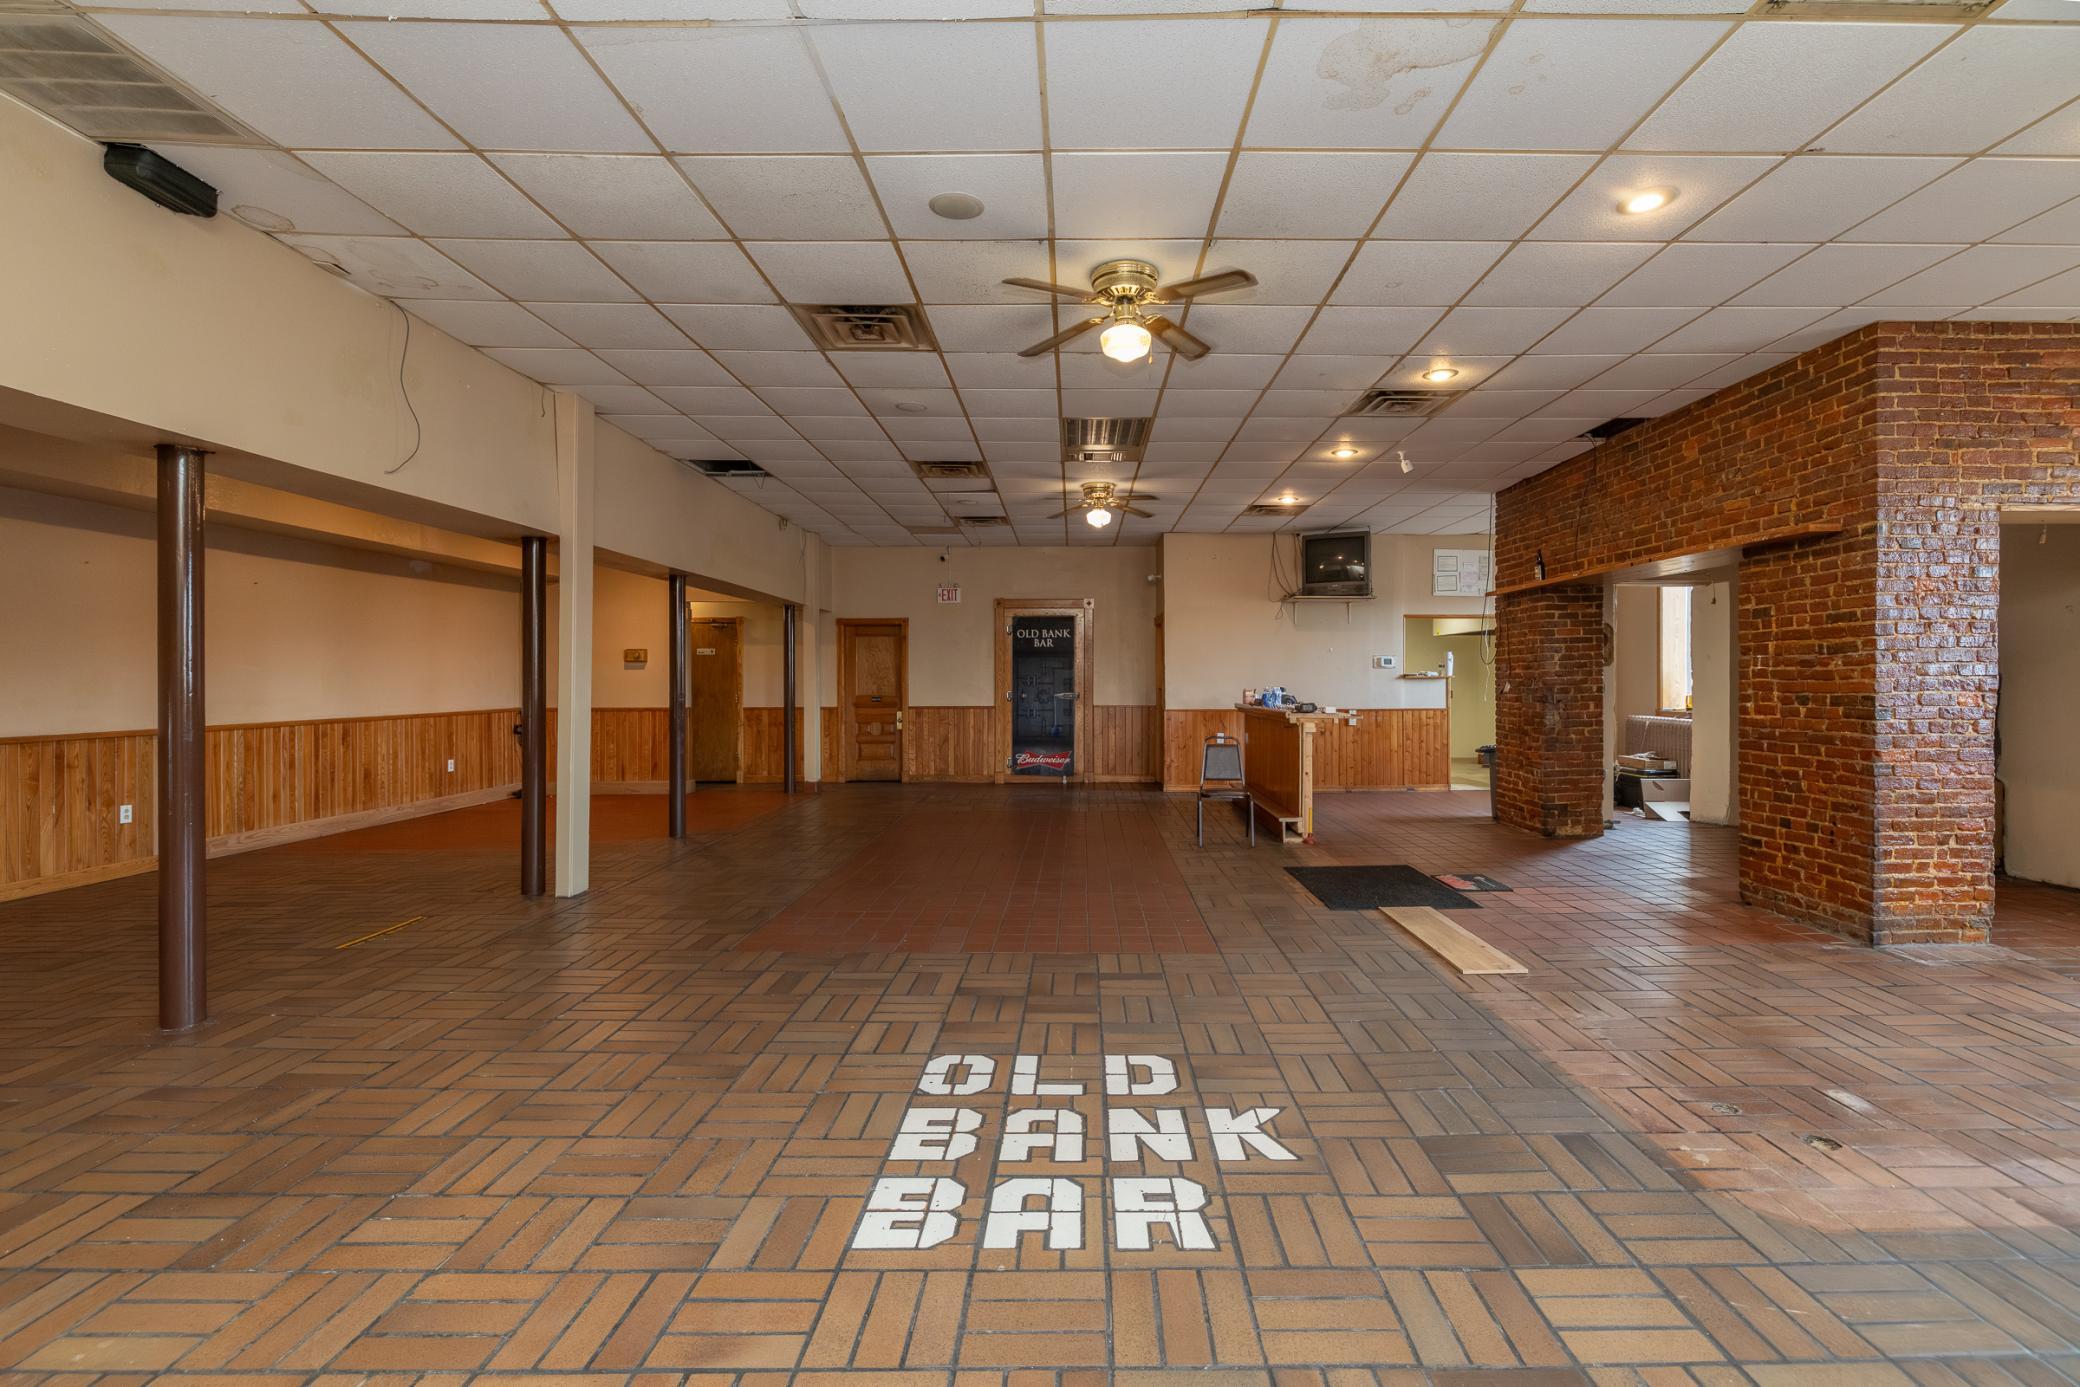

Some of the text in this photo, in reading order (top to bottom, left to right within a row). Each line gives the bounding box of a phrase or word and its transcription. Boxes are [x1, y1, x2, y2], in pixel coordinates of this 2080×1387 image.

[942, 589, 957, 601] EXIT
[1017, 629, 1071, 638] OLD BANK
[1034, 639, 1054, 648] BAR
[1016, 752, 1071, 766] Budweiser
[918, 1054, 1180, 1096] OLD
[888, 1107, 1299, 1162] BANK
[851, 1177, 1218, 1250] BAR
